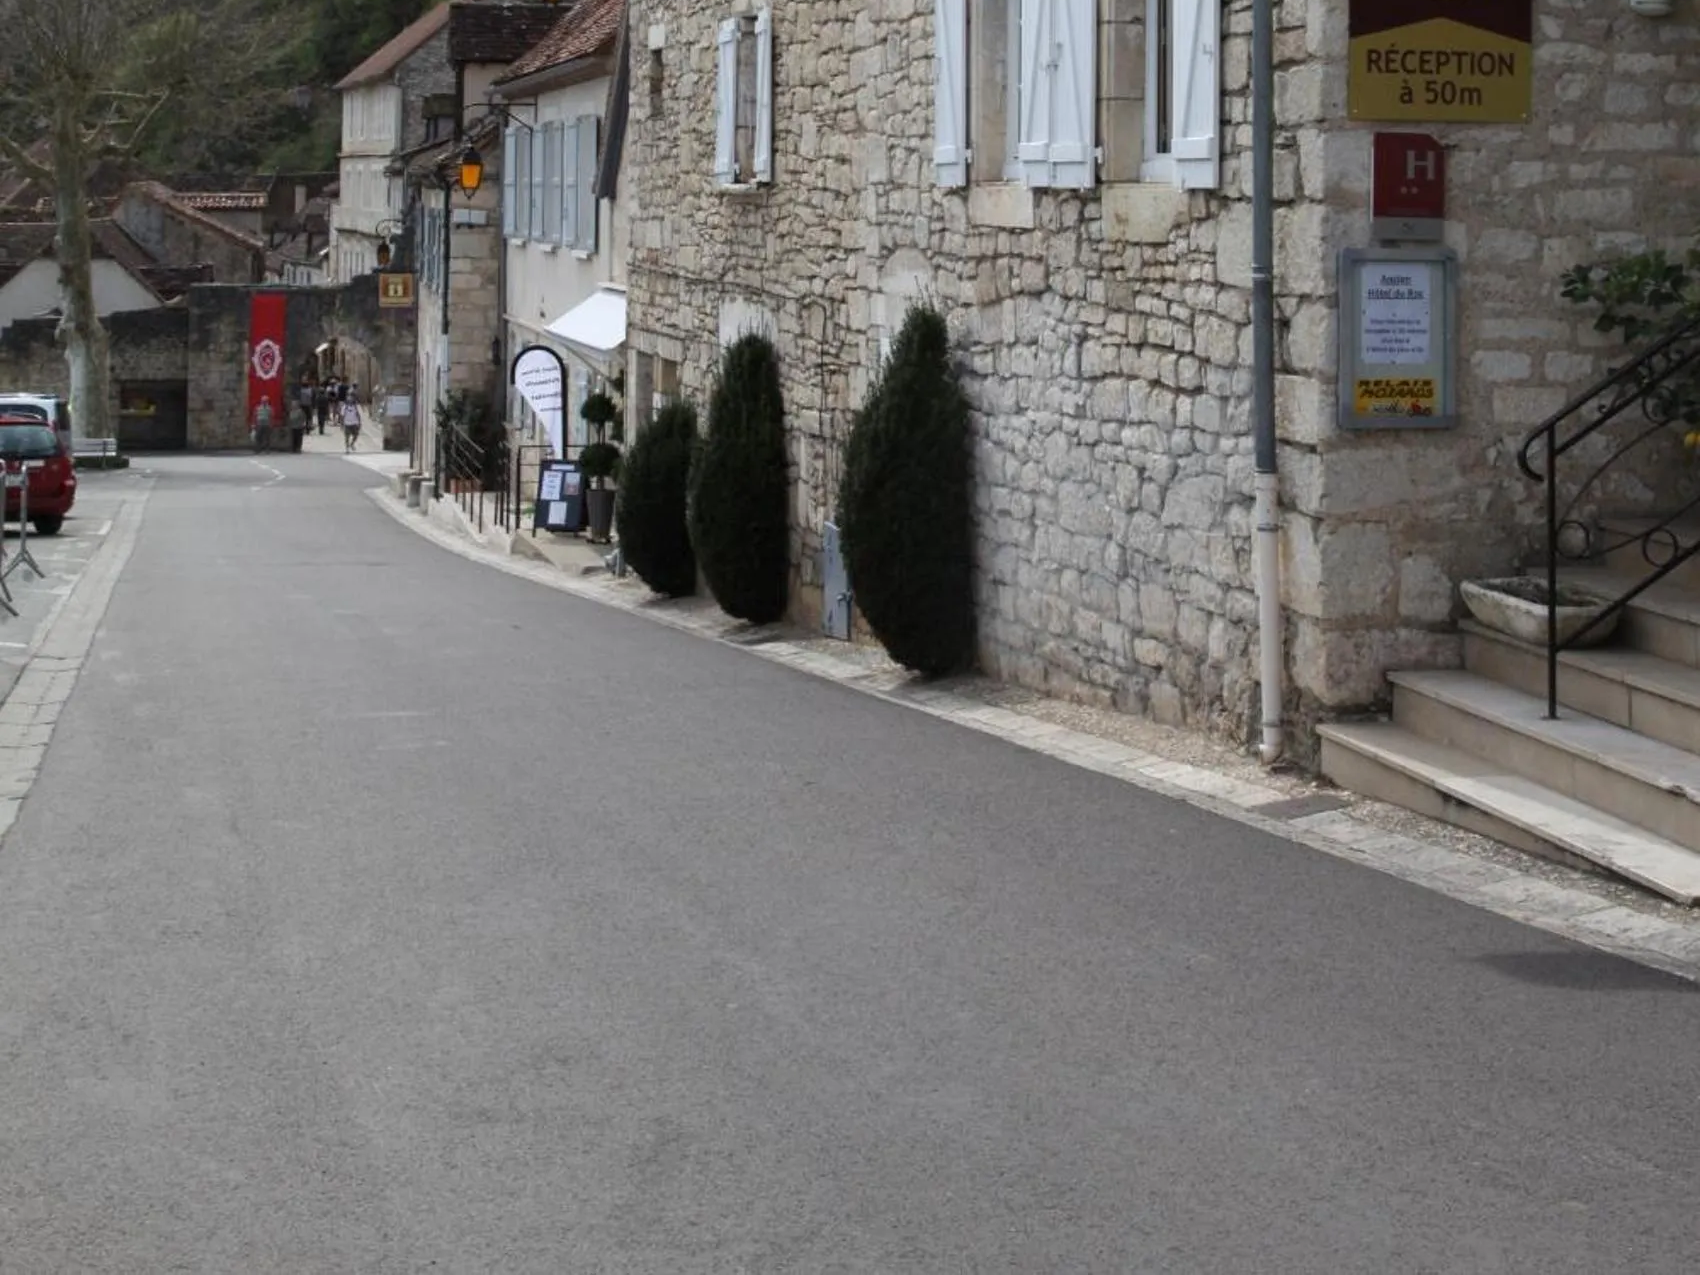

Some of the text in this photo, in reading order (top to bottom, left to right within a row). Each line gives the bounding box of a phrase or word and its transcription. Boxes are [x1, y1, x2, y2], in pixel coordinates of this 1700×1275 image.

[1366, 42, 1516, 78] RÉCEPTION
[1398, 78, 1483, 106] à 50m
[1405, 149, 1436, 181] H
